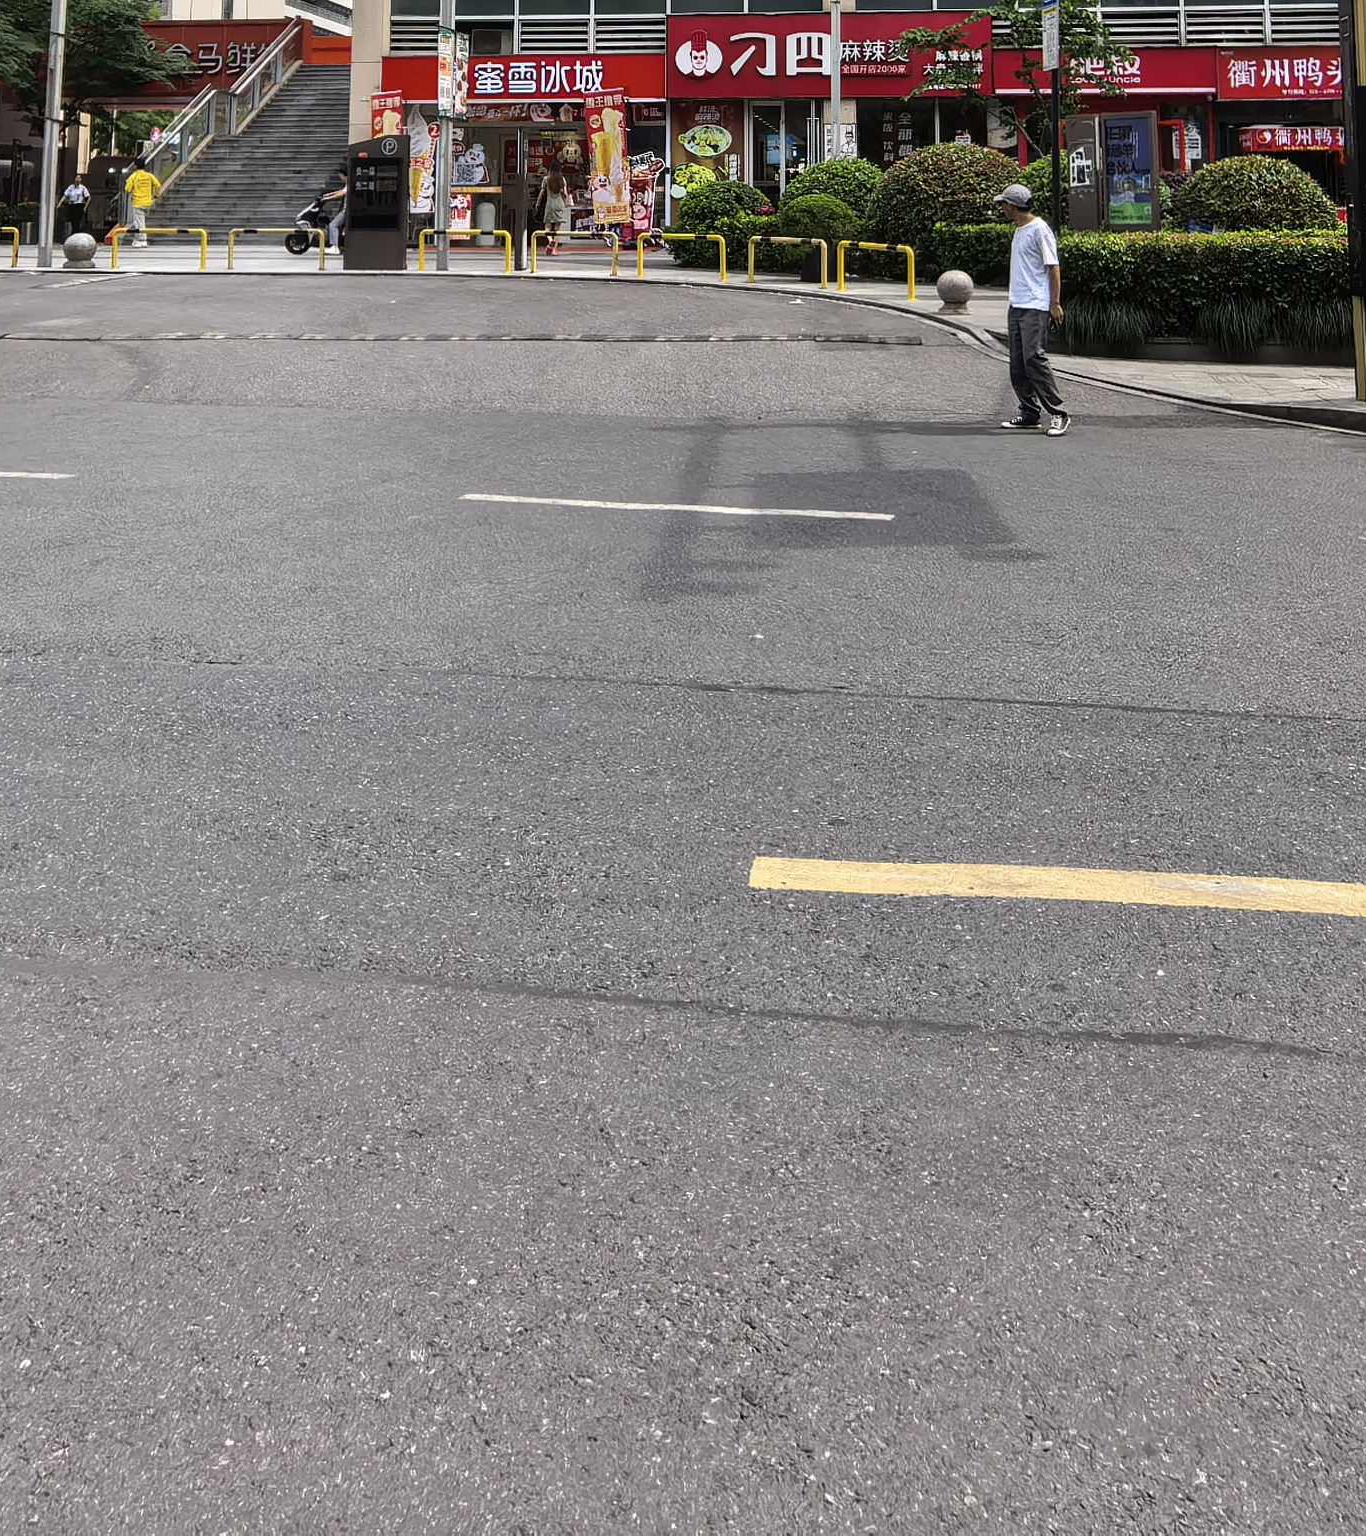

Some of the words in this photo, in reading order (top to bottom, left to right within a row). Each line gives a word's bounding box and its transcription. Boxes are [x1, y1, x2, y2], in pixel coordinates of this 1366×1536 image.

[730, 31, 832, 77] 刁四
[474, 61, 603, 94] 蜜雪冰城
